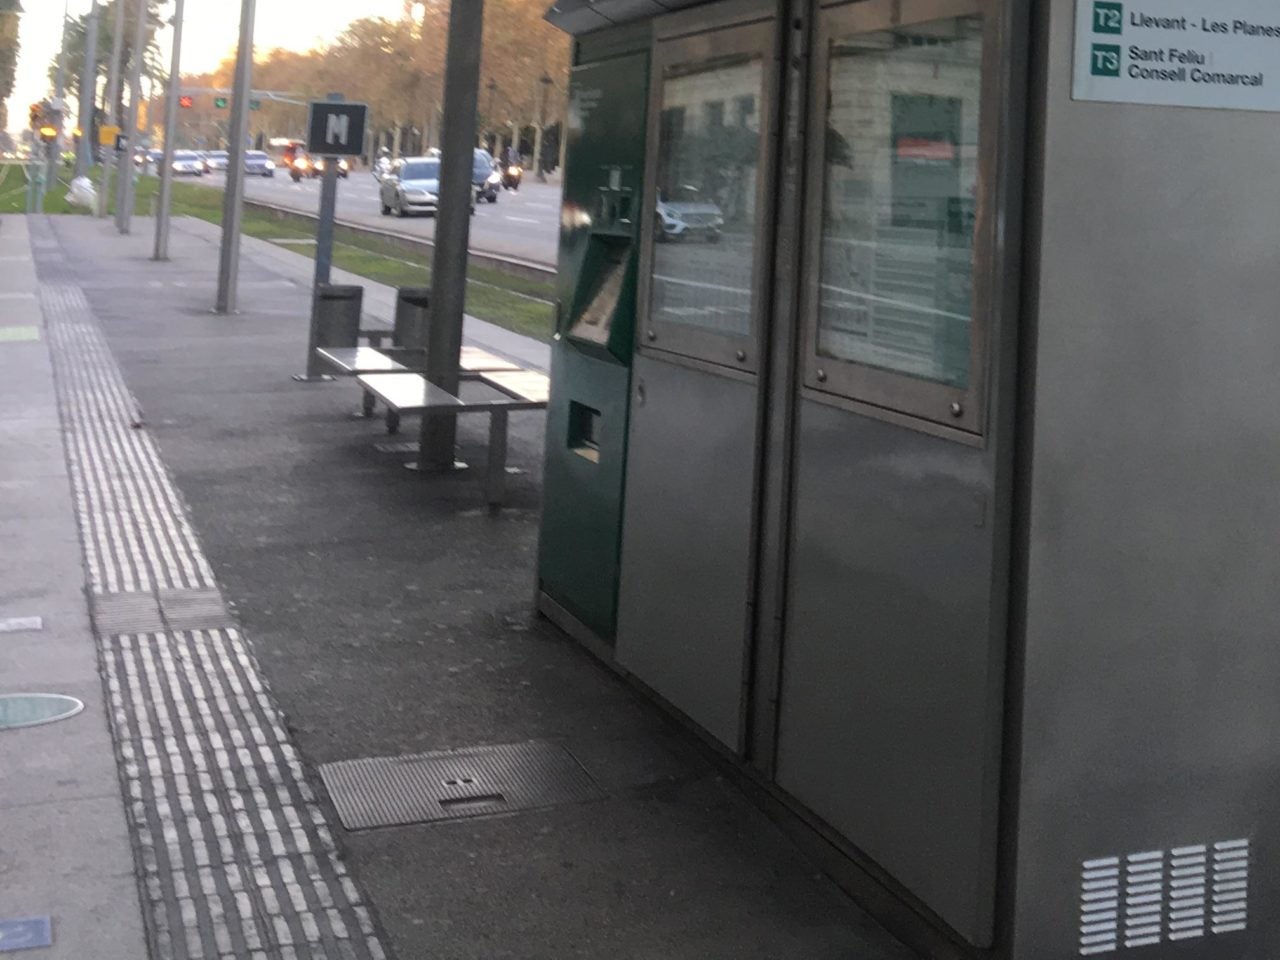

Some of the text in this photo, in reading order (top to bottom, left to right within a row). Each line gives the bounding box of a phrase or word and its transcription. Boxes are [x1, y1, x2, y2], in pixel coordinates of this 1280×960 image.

[1095, 7, 1121, 27] T2
[1130, 12, 1186, 30] Llevant
[1201, 18, 1228, 35] Les
[1093, 50, 1119, 70] T3
[1128, 46, 1205, 66] Sant Feliu
[1127, 64, 1263, 87] Consell Comarcal
